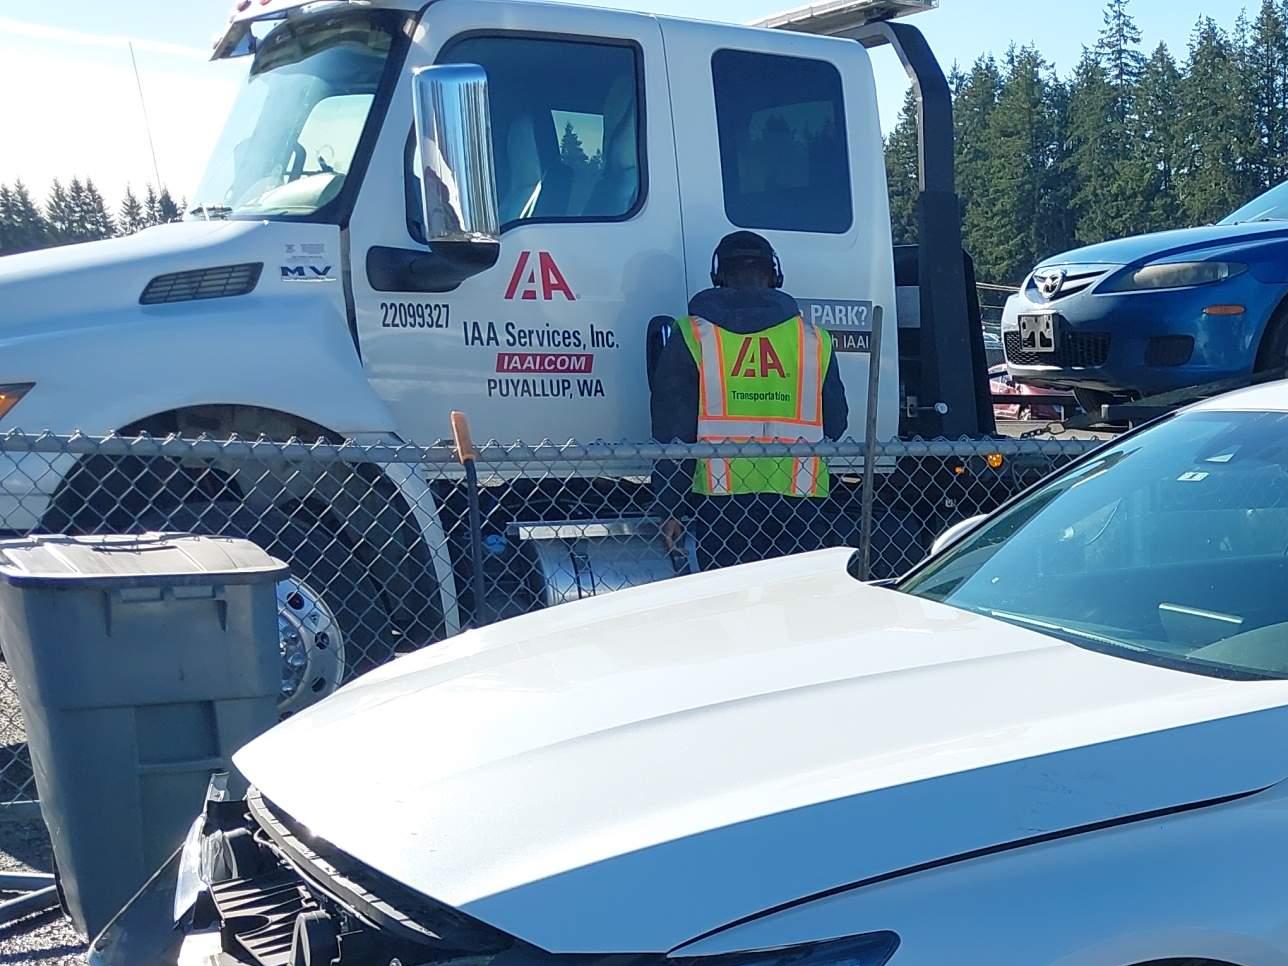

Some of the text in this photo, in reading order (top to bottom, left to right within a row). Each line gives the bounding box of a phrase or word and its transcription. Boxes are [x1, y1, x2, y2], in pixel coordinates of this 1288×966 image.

[280, 266, 331, 277] MV
[380, 303, 450, 328] 22099327
[811, 304, 867, 326] PARK?
[463, 322, 620, 350] IAA Services, Inc.
[503, 355, 586, 371] IAAI.COM
[487, 378, 605, 399] PUYALLUP, WA
[732, 390, 791, 402] Transportation
